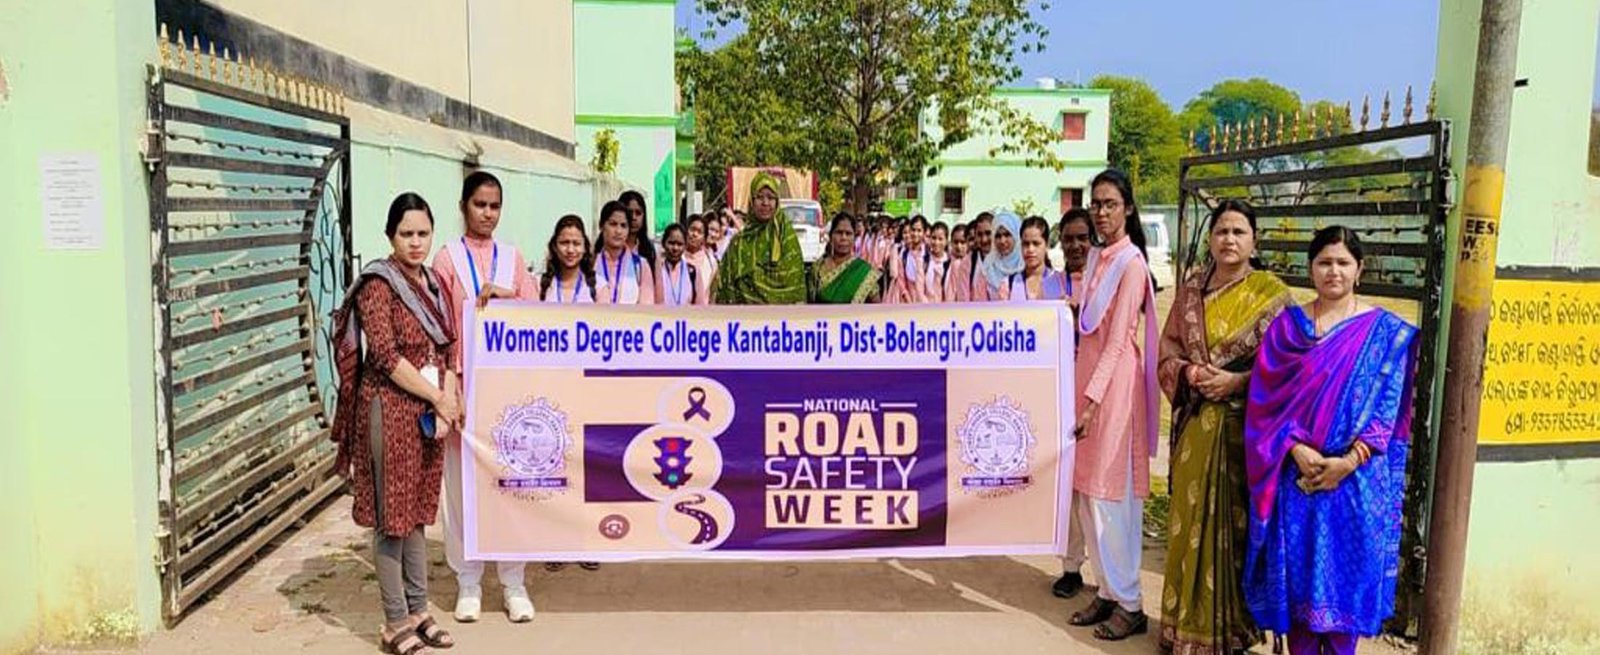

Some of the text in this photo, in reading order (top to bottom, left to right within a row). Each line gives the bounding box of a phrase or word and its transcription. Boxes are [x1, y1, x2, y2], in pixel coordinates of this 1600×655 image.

[484, 321, 569, 352] Womens
[576, 321, 644, 362] Degree
[650, 321, 721, 362] College
[728, 321, 833, 361] Kantabanji,
[804, 399, 879, 412] NATIONAL
[765, 412, 918, 456] ROAD
[765, 457, 917, 489] SAFETY
[773, 495, 910, 524] WEEK
